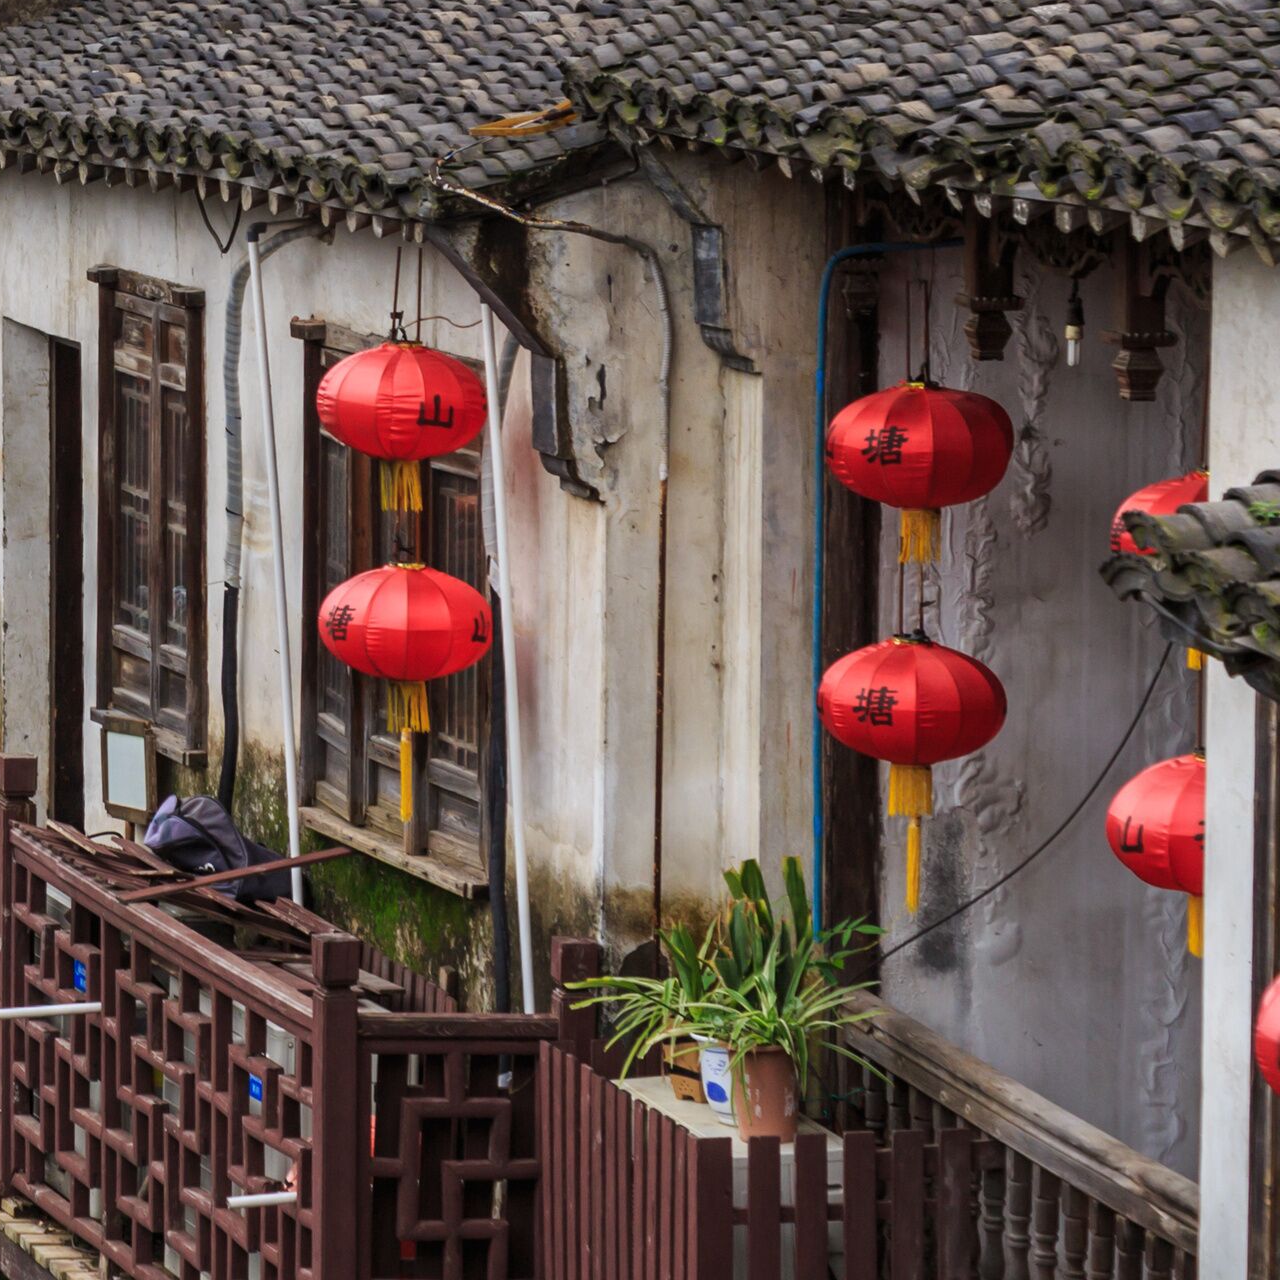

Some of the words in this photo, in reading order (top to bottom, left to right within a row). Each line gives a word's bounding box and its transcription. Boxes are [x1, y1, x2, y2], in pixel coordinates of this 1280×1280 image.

[417, 395, 453, 429] 山
[861, 426, 909, 466] 塘
[325, 604, 356, 642] 塘
[471, 610, 488, 644] 山
[851, 686, 899, 727] 塘
